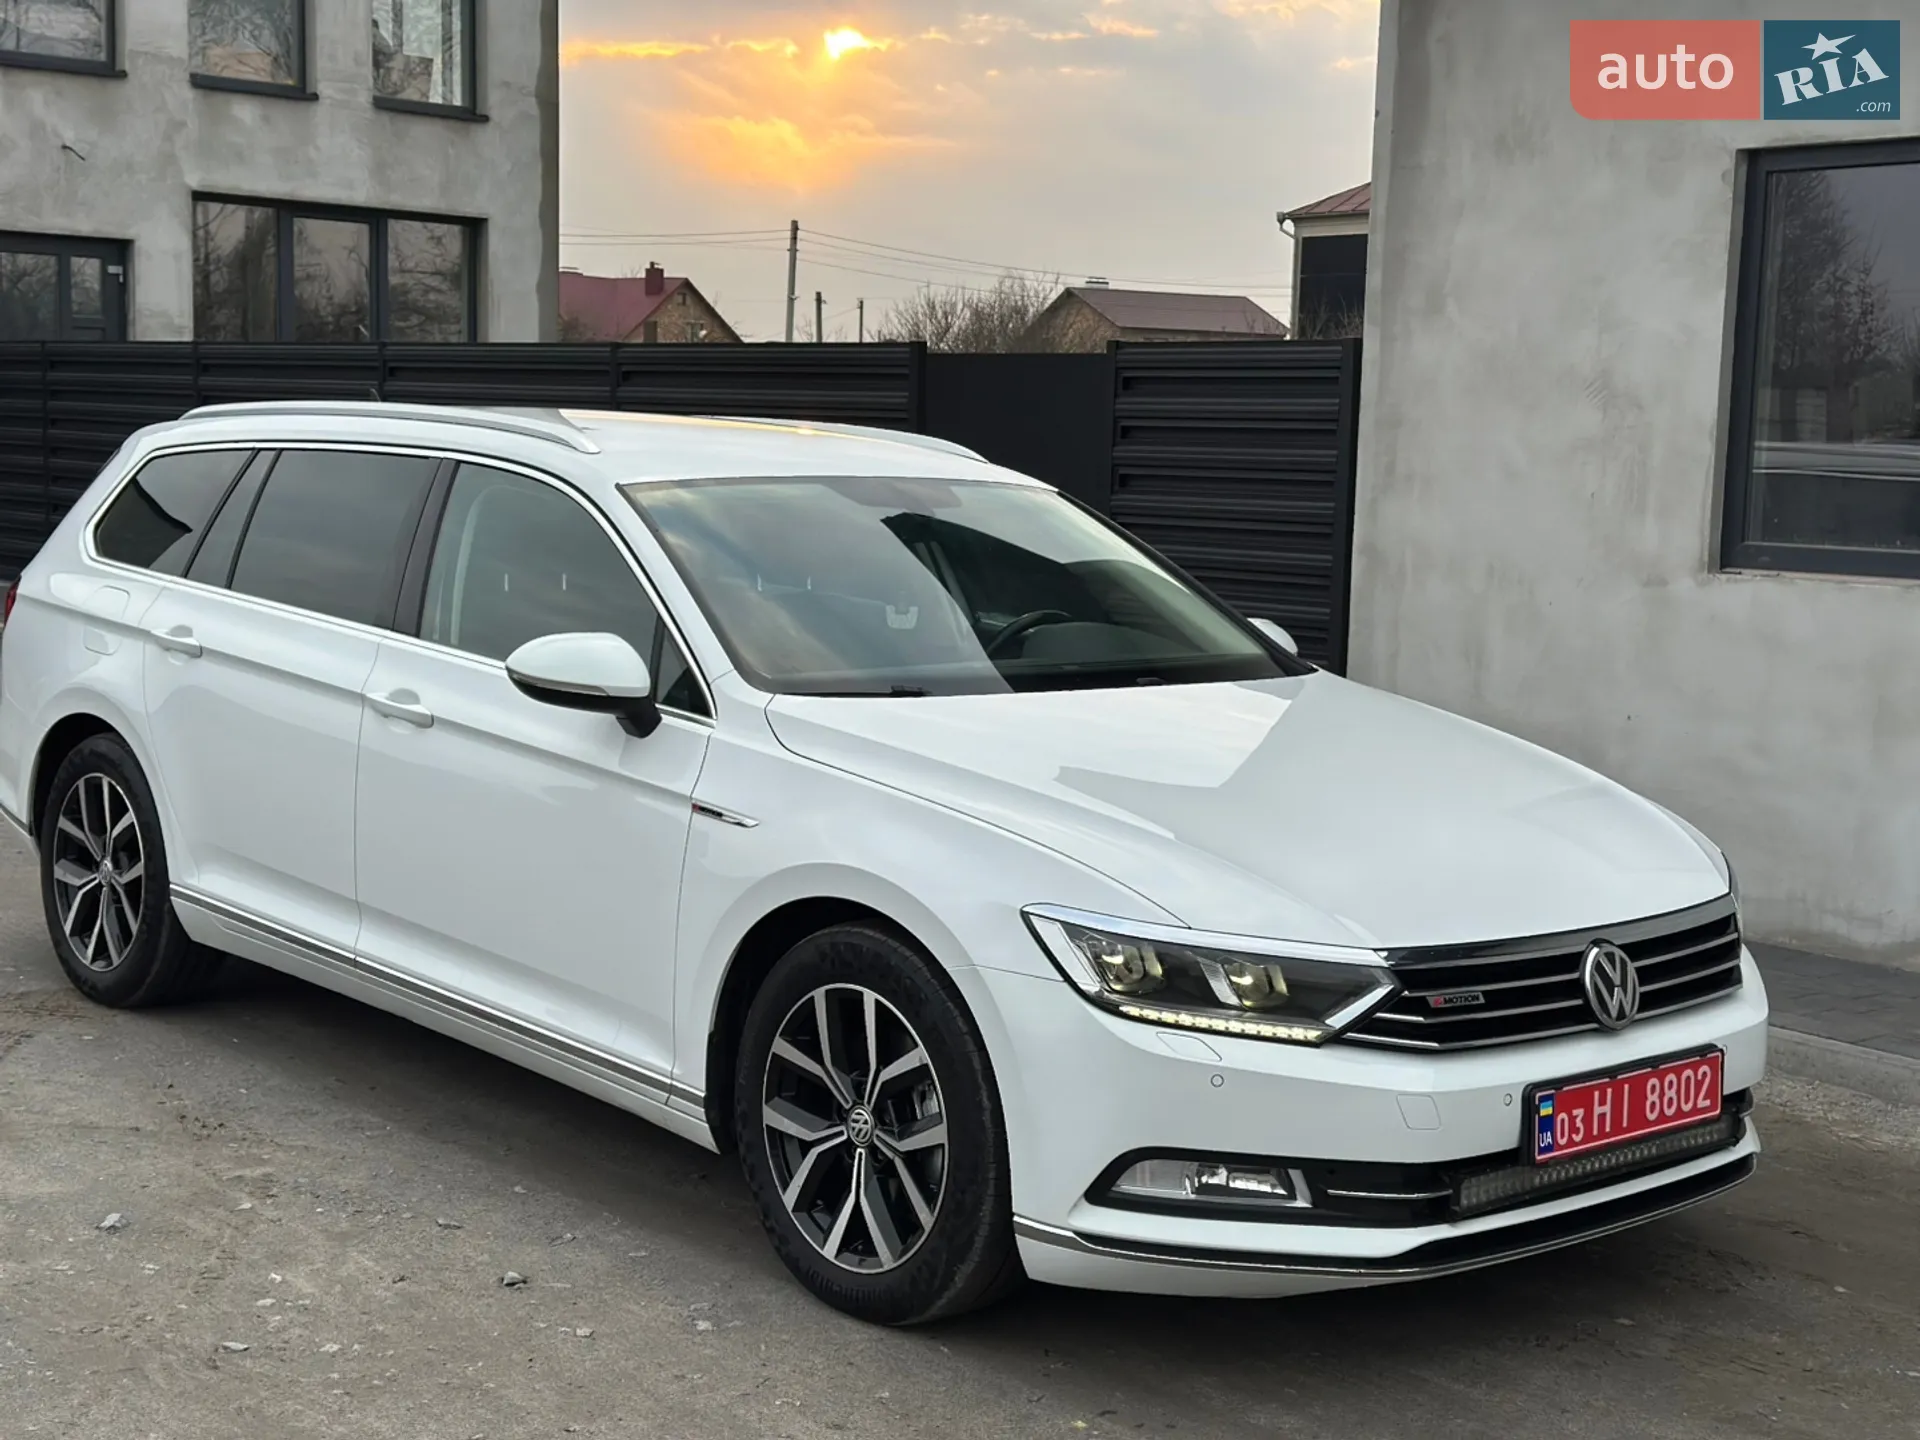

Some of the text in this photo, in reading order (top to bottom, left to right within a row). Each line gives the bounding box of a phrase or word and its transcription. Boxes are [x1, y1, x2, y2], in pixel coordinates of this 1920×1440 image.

[1556, 1064, 1712, 1146] 03 HI 8802
[1539, 1131, 1553, 1147] UA
